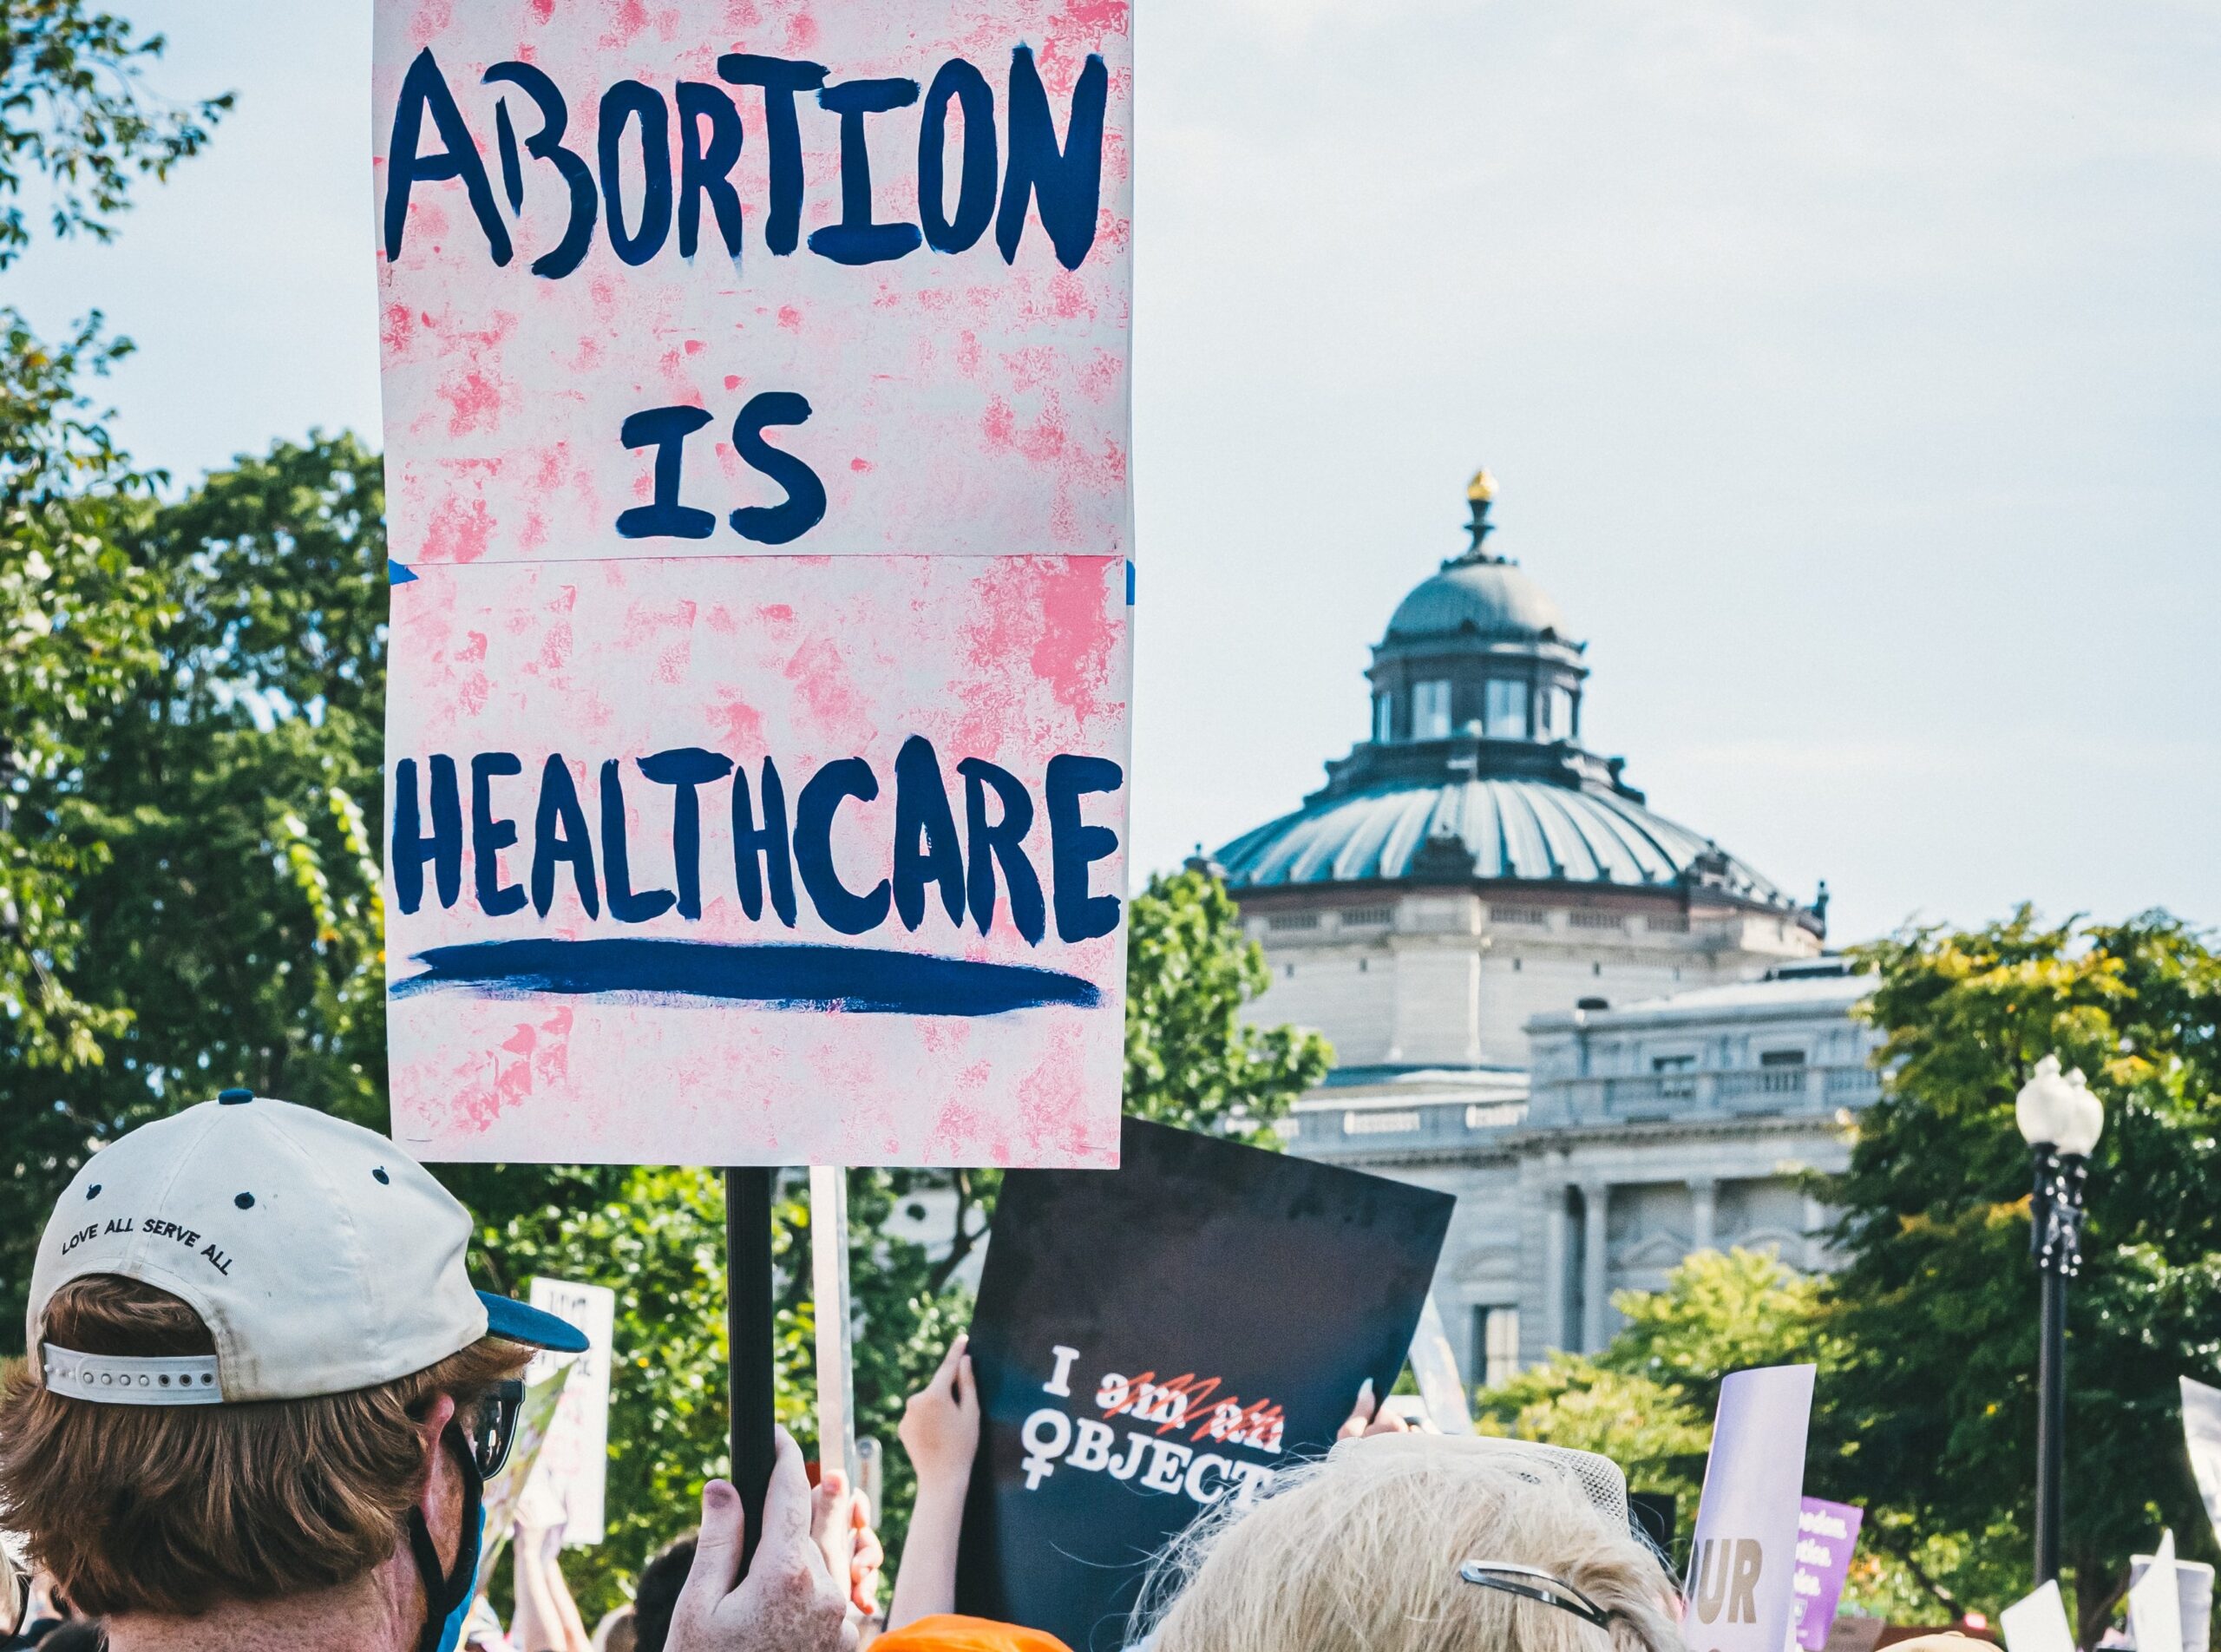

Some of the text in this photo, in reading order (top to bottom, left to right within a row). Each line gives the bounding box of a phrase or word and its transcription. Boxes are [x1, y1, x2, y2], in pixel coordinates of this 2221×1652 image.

[383, 40, 1109, 280] ABORTION
[616, 391, 827, 545] IS
[392, 734, 1124, 947] HEALTHCARE
[62, 1218, 233, 1276] LOVE ALL SERVE ALL
[1042, 1345, 1080, 1398] I
[1095, 1373, 1187, 1430] am
[1687, 1538, 1763, 1625] UR
